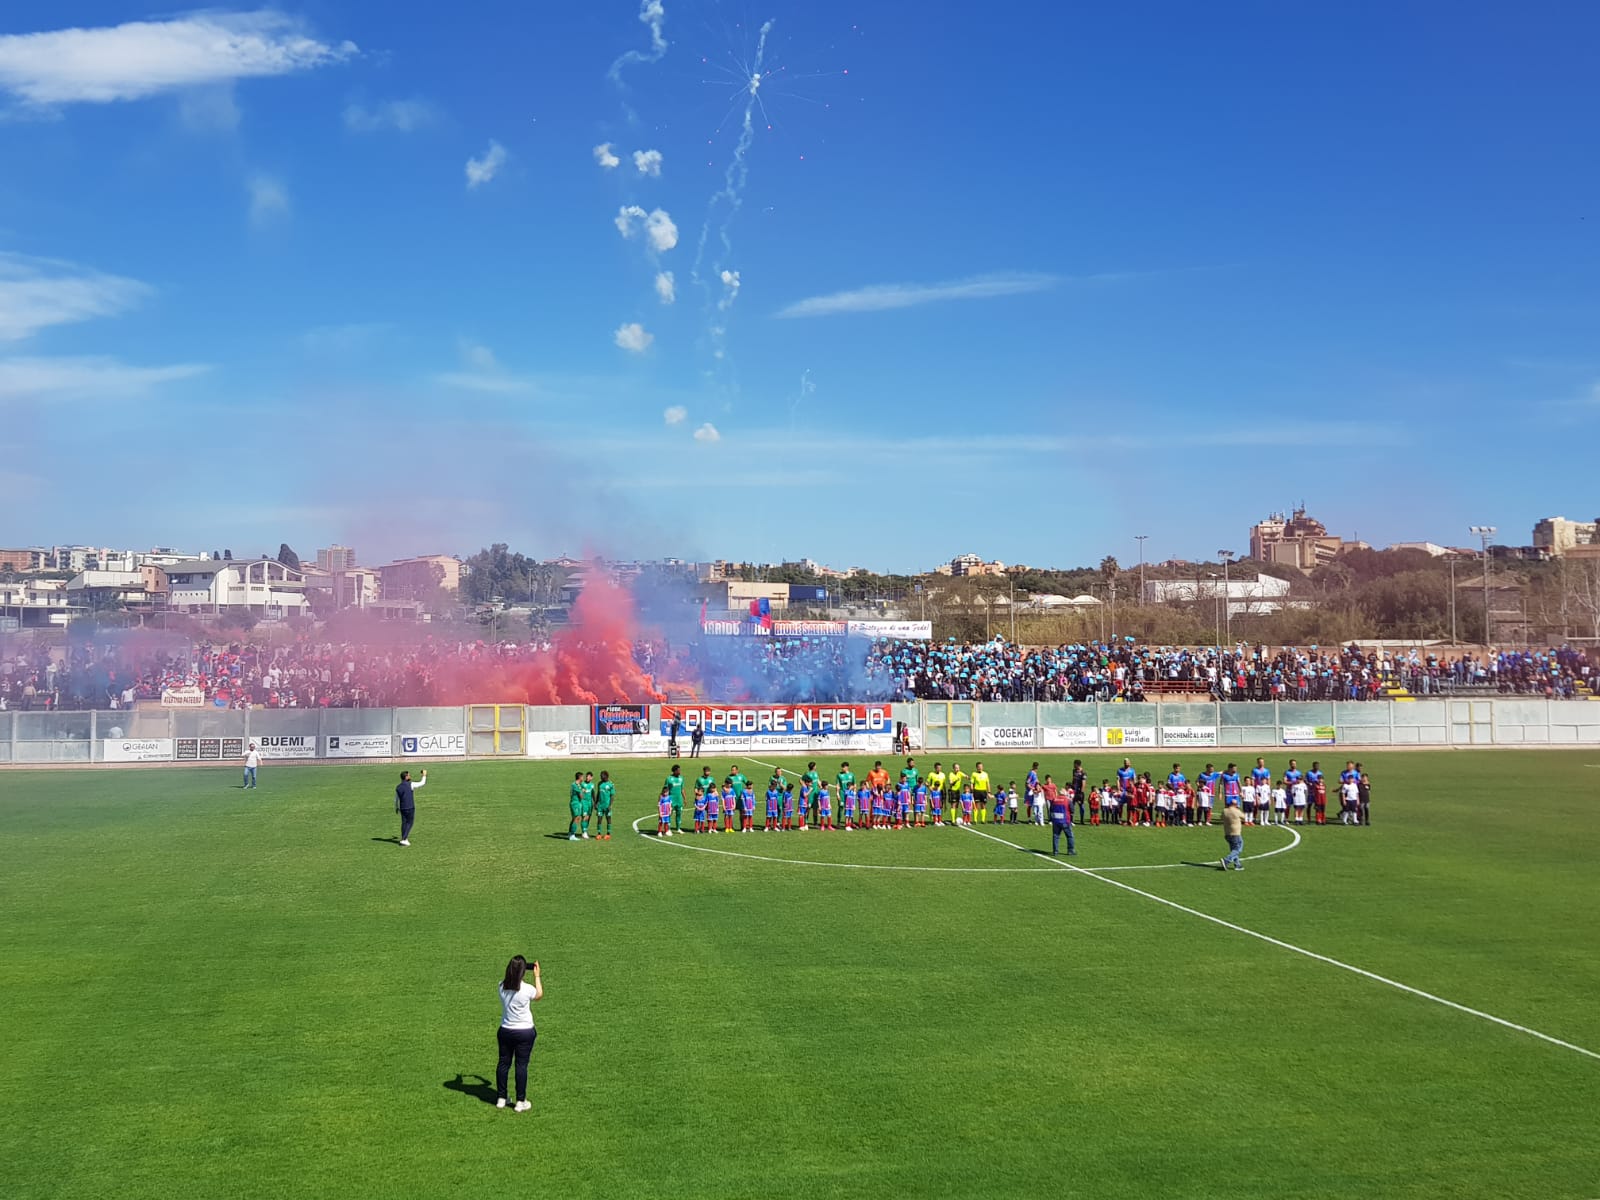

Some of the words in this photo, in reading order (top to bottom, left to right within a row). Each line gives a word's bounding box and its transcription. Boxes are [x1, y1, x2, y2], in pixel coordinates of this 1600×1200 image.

[685, 709, 706, 732] DI
[711, 709, 788, 732] PADRE
[793, 708, 813, 731] IN
[818, 708, 885, 731] FIGLIO
[993, 728, 1033, 738] COGEKAT
[1124, 729, 1141, 737] Luigi
[261, 737, 304, 746] BUEMI
[419, 736, 465, 749] GALPE
[573, 736, 619, 745] ETNAPOLIS
[702, 737, 749, 745] CIBIESSE
